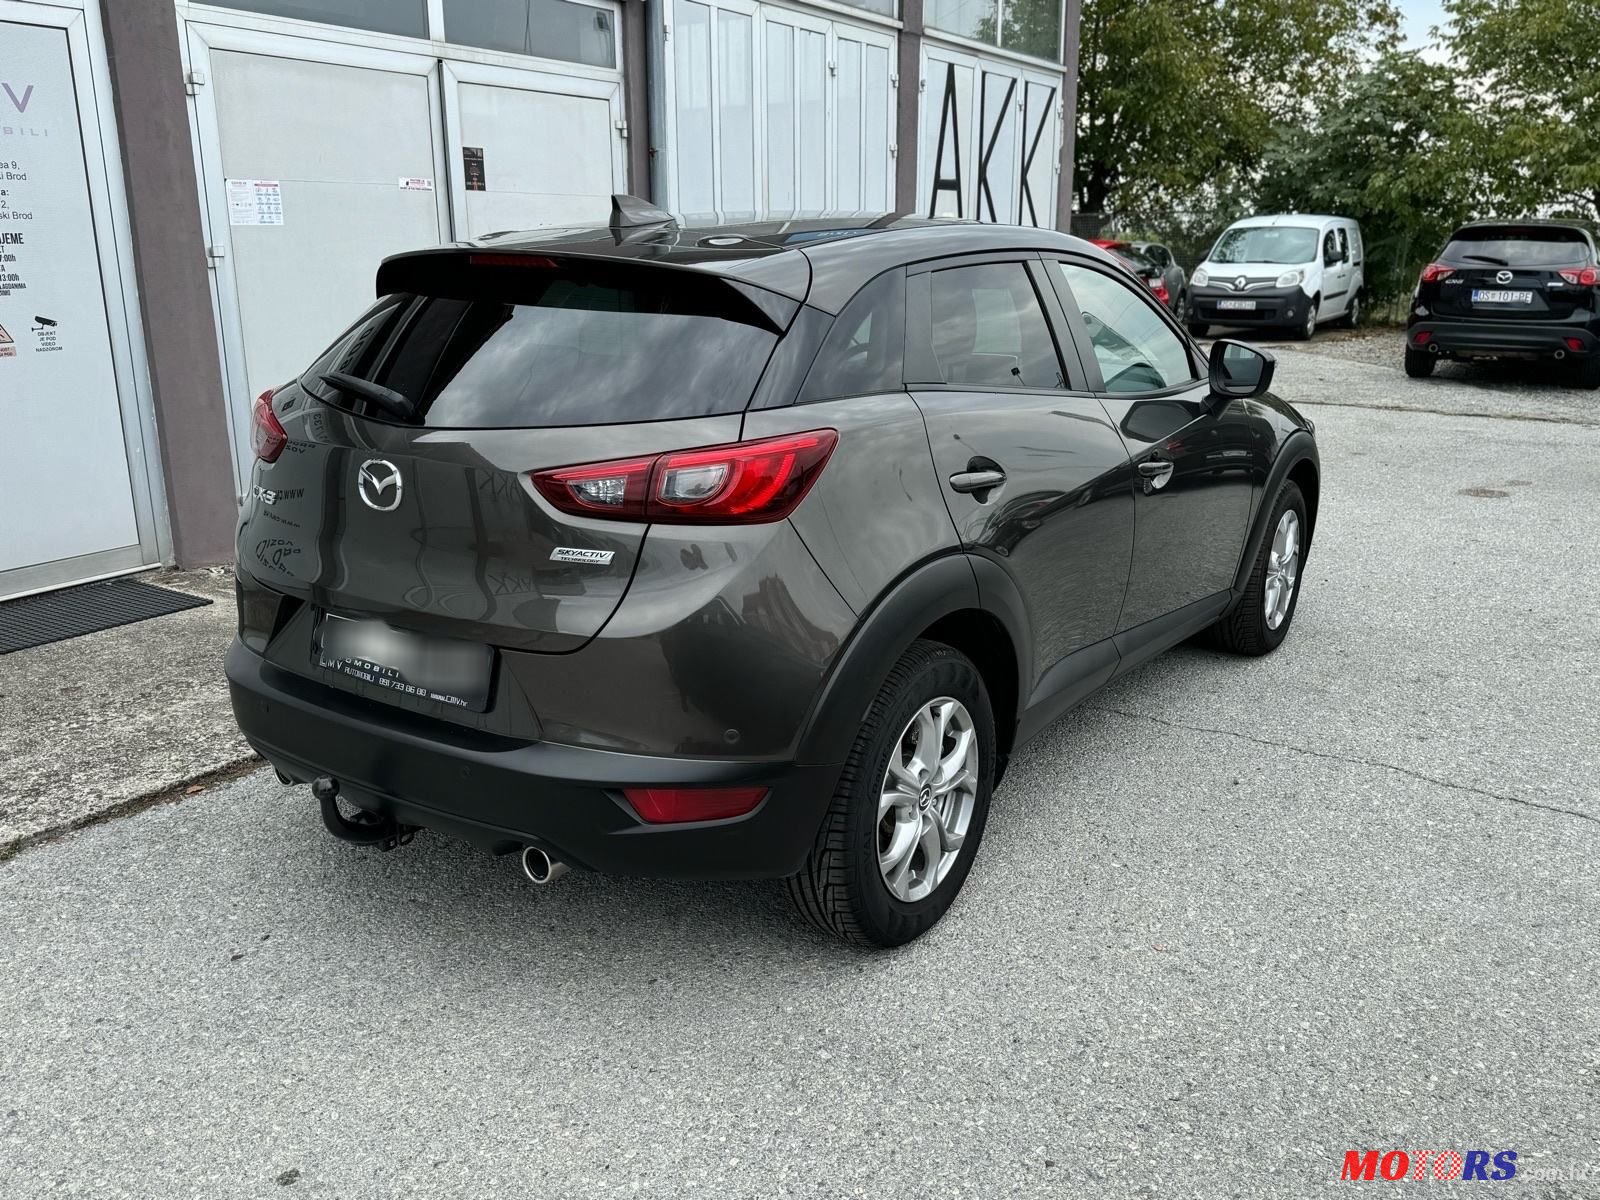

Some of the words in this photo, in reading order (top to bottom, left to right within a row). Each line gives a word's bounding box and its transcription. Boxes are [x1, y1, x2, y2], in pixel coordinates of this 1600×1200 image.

[6, 171, 27, 181] Brod
[12, 211, 33, 220] Brod
[556, 548, 608, 558] SKYACTIV
